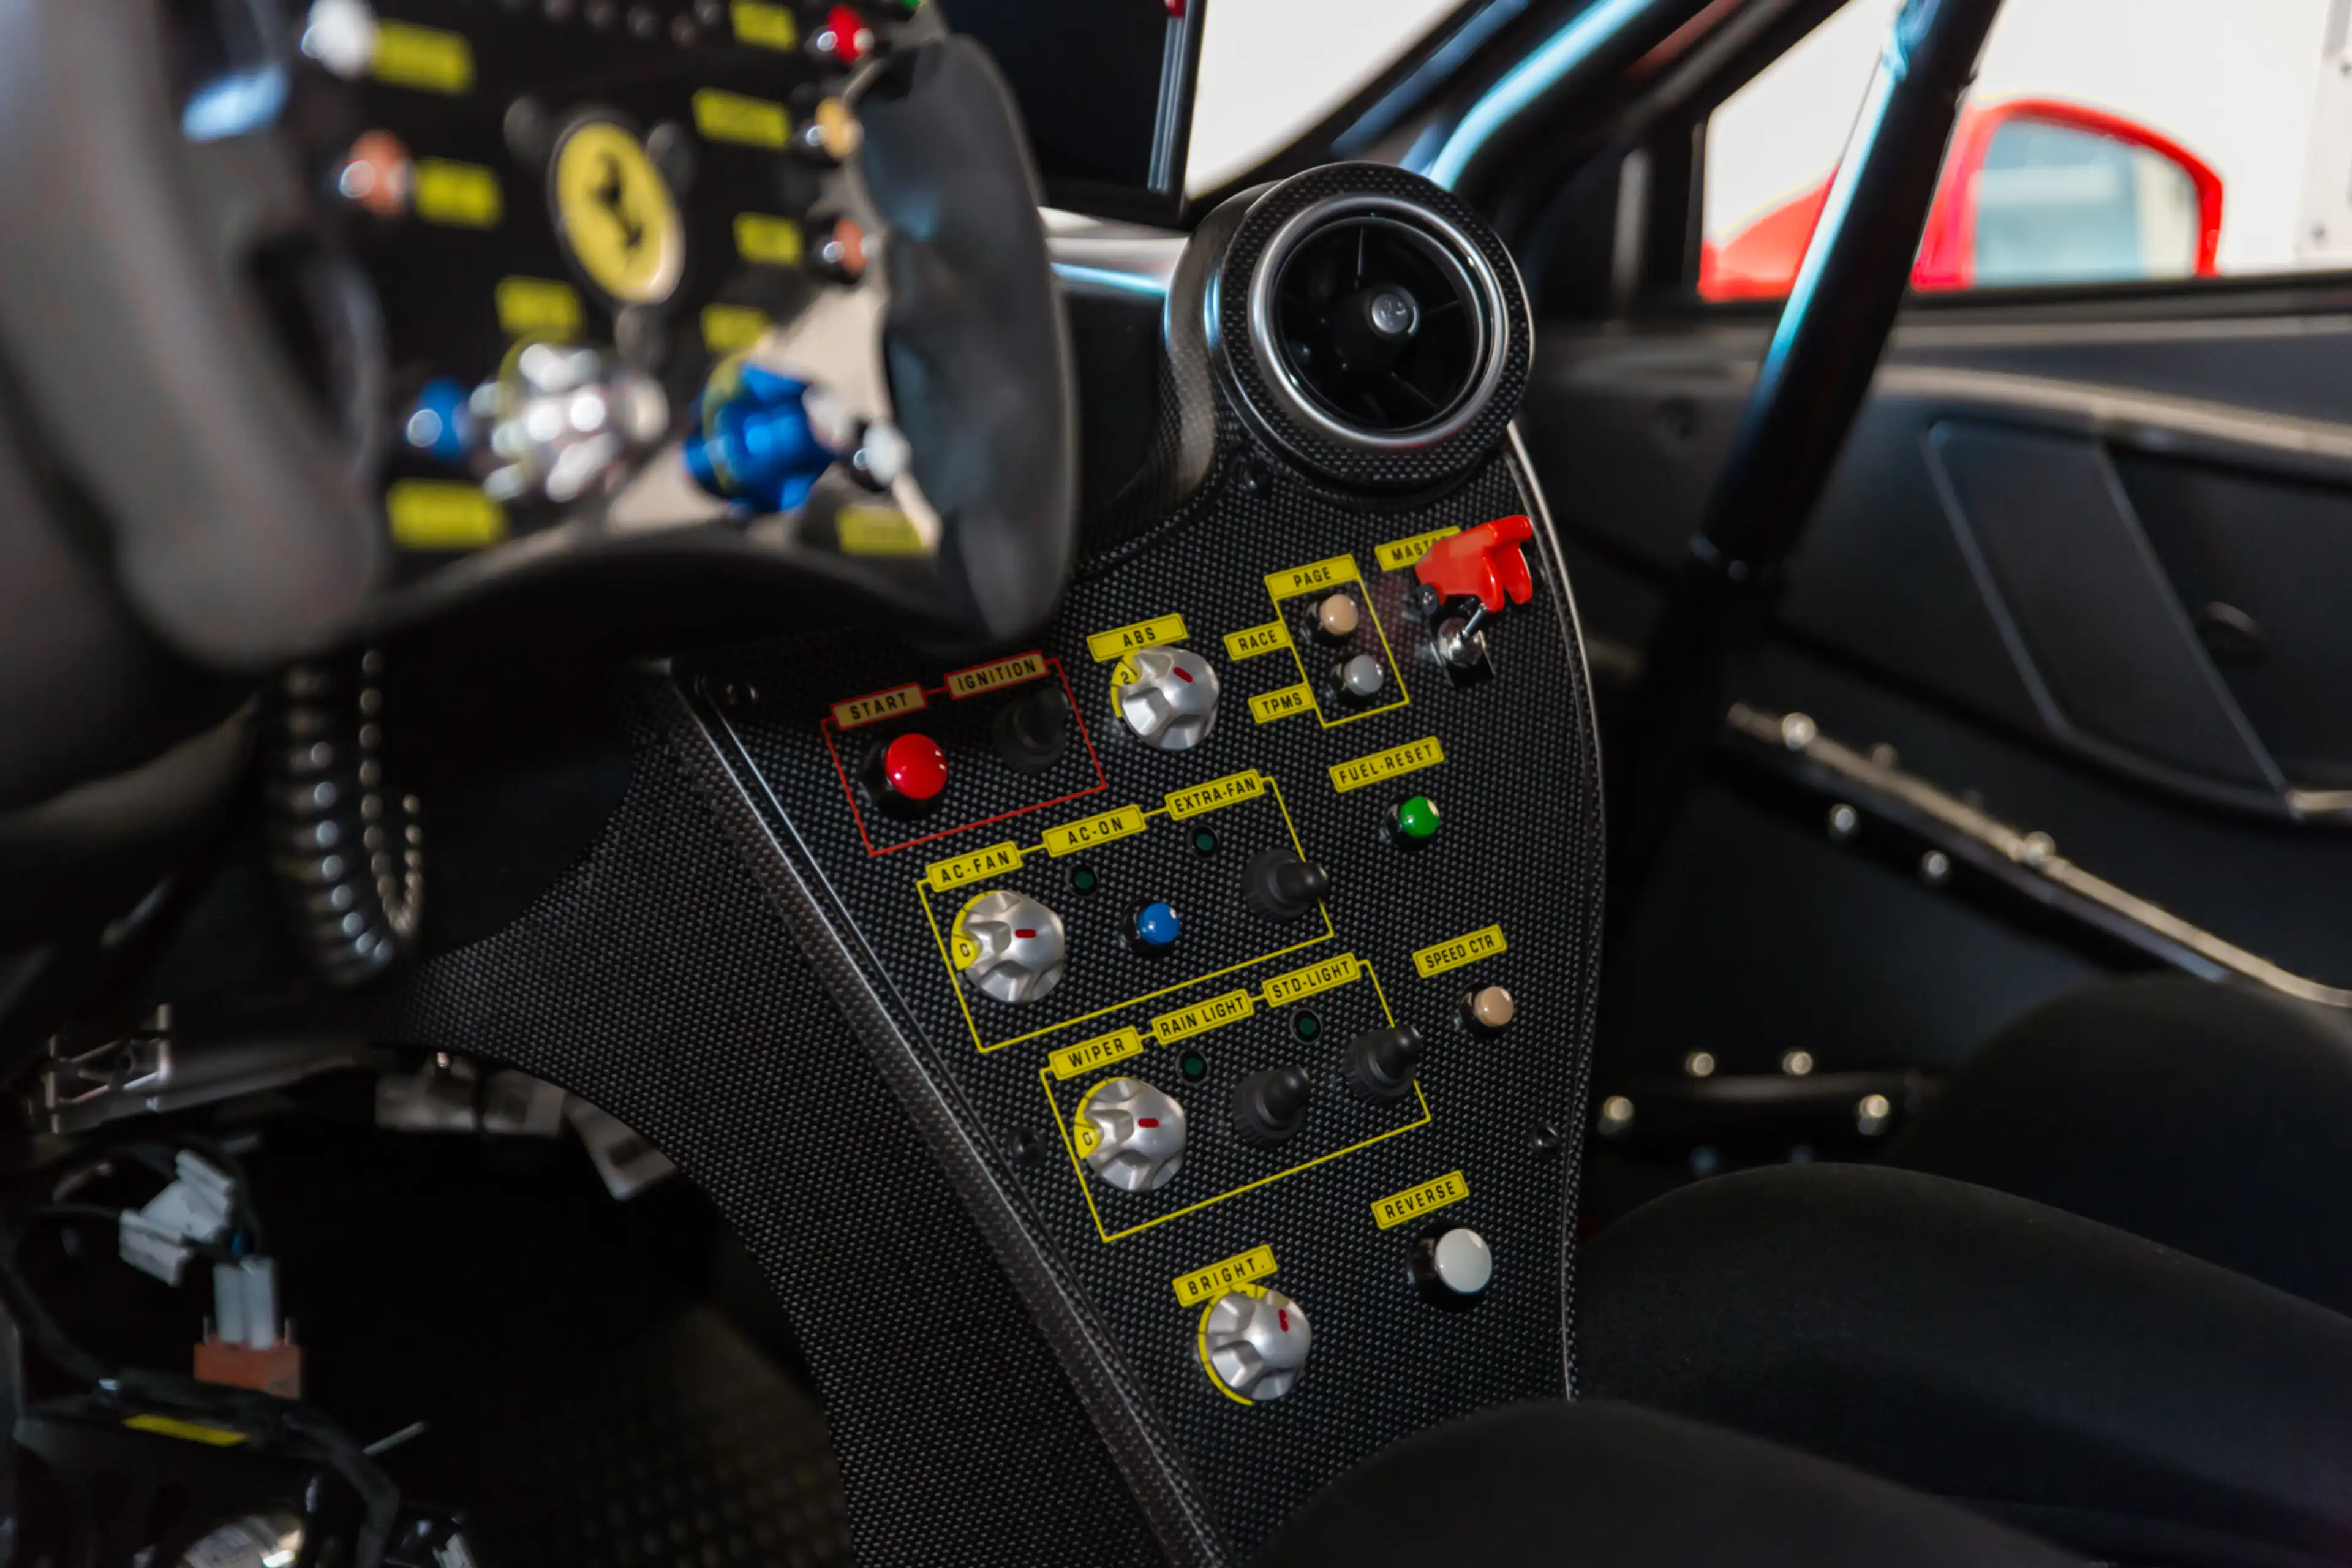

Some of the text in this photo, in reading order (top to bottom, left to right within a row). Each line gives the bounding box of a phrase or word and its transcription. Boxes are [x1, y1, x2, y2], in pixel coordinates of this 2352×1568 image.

[1293, 567, 1332, 587] PAGE
[1123, 627, 1156, 647] ABS
[1238, 629, 1278, 651] RACE
[957, 662, 1036, 692] IGNITION
[1120, 671, 1131, 685] 2
[850, 693, 908, 720] START
[1262, 693, 1303, 714] TPMS
[1425, 935, 1494, 969] SPEED CTR
[1160, 997, 1245, 1037] RAIN LIGHT
[1068, 1038, 1125, 1068] WIPER
[1384, 1180, 1455, 1219] REVERSE
